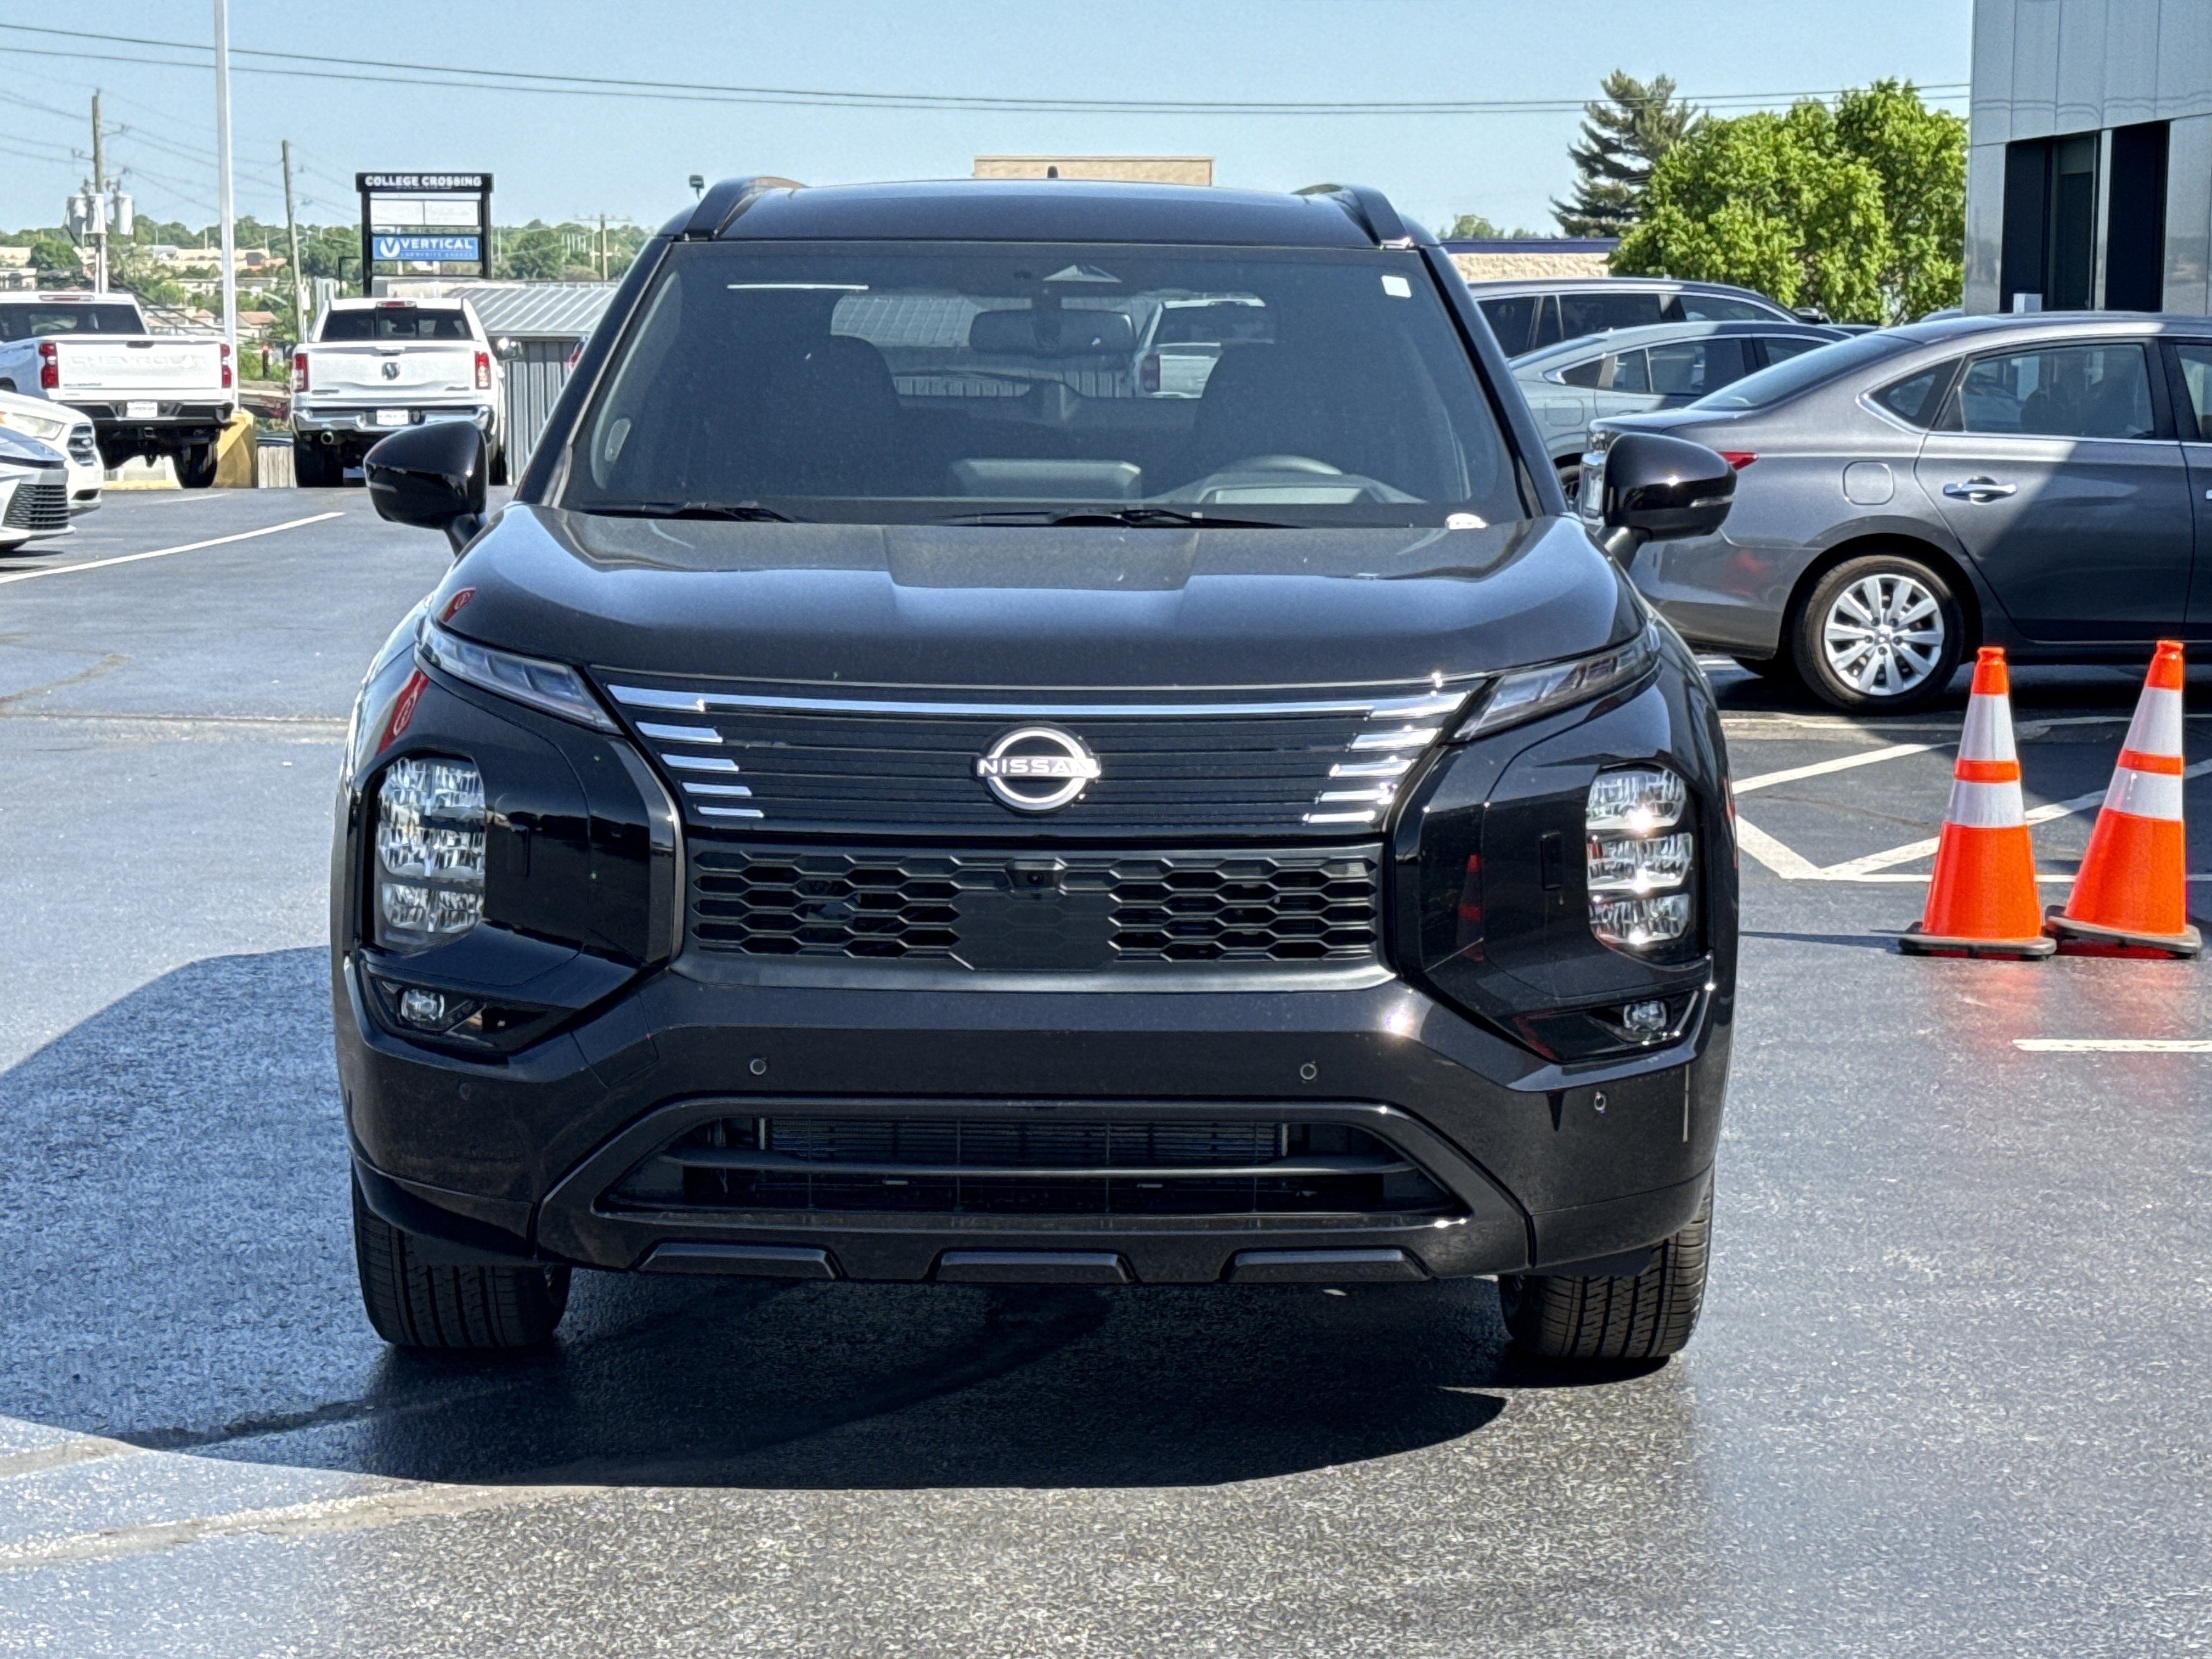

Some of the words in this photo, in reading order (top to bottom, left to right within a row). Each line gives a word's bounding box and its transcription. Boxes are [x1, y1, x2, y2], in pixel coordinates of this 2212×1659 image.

[365, 176, 419, 187] COLLEGE
[421, 176, 482, 187] CROSSING
[400, 238, 473, 250] VERTICAL
[69, 356, 207, 368] CHEVROLT
[979, 759, 1097, 775] NISSAN
